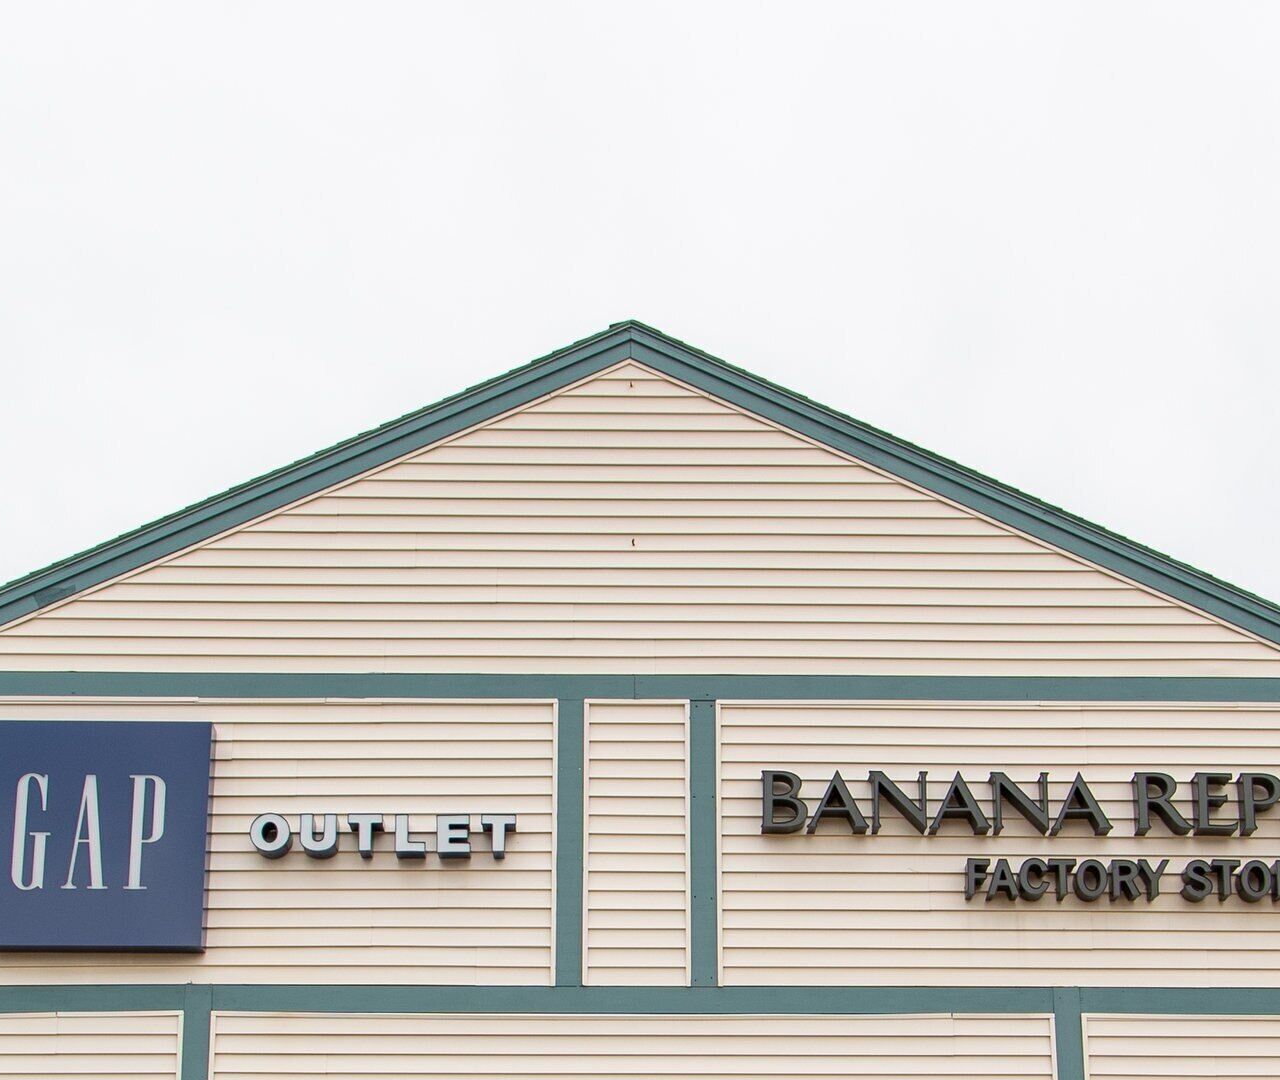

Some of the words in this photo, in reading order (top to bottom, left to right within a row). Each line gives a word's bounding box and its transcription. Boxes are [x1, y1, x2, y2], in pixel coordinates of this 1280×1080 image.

[11, 773, 166, 890] GAP
[760, 769, 1111, 837] BANANA
[249, 812, 517, 860] OUTLET
[964, 858, 1168, 903] FACTORY
